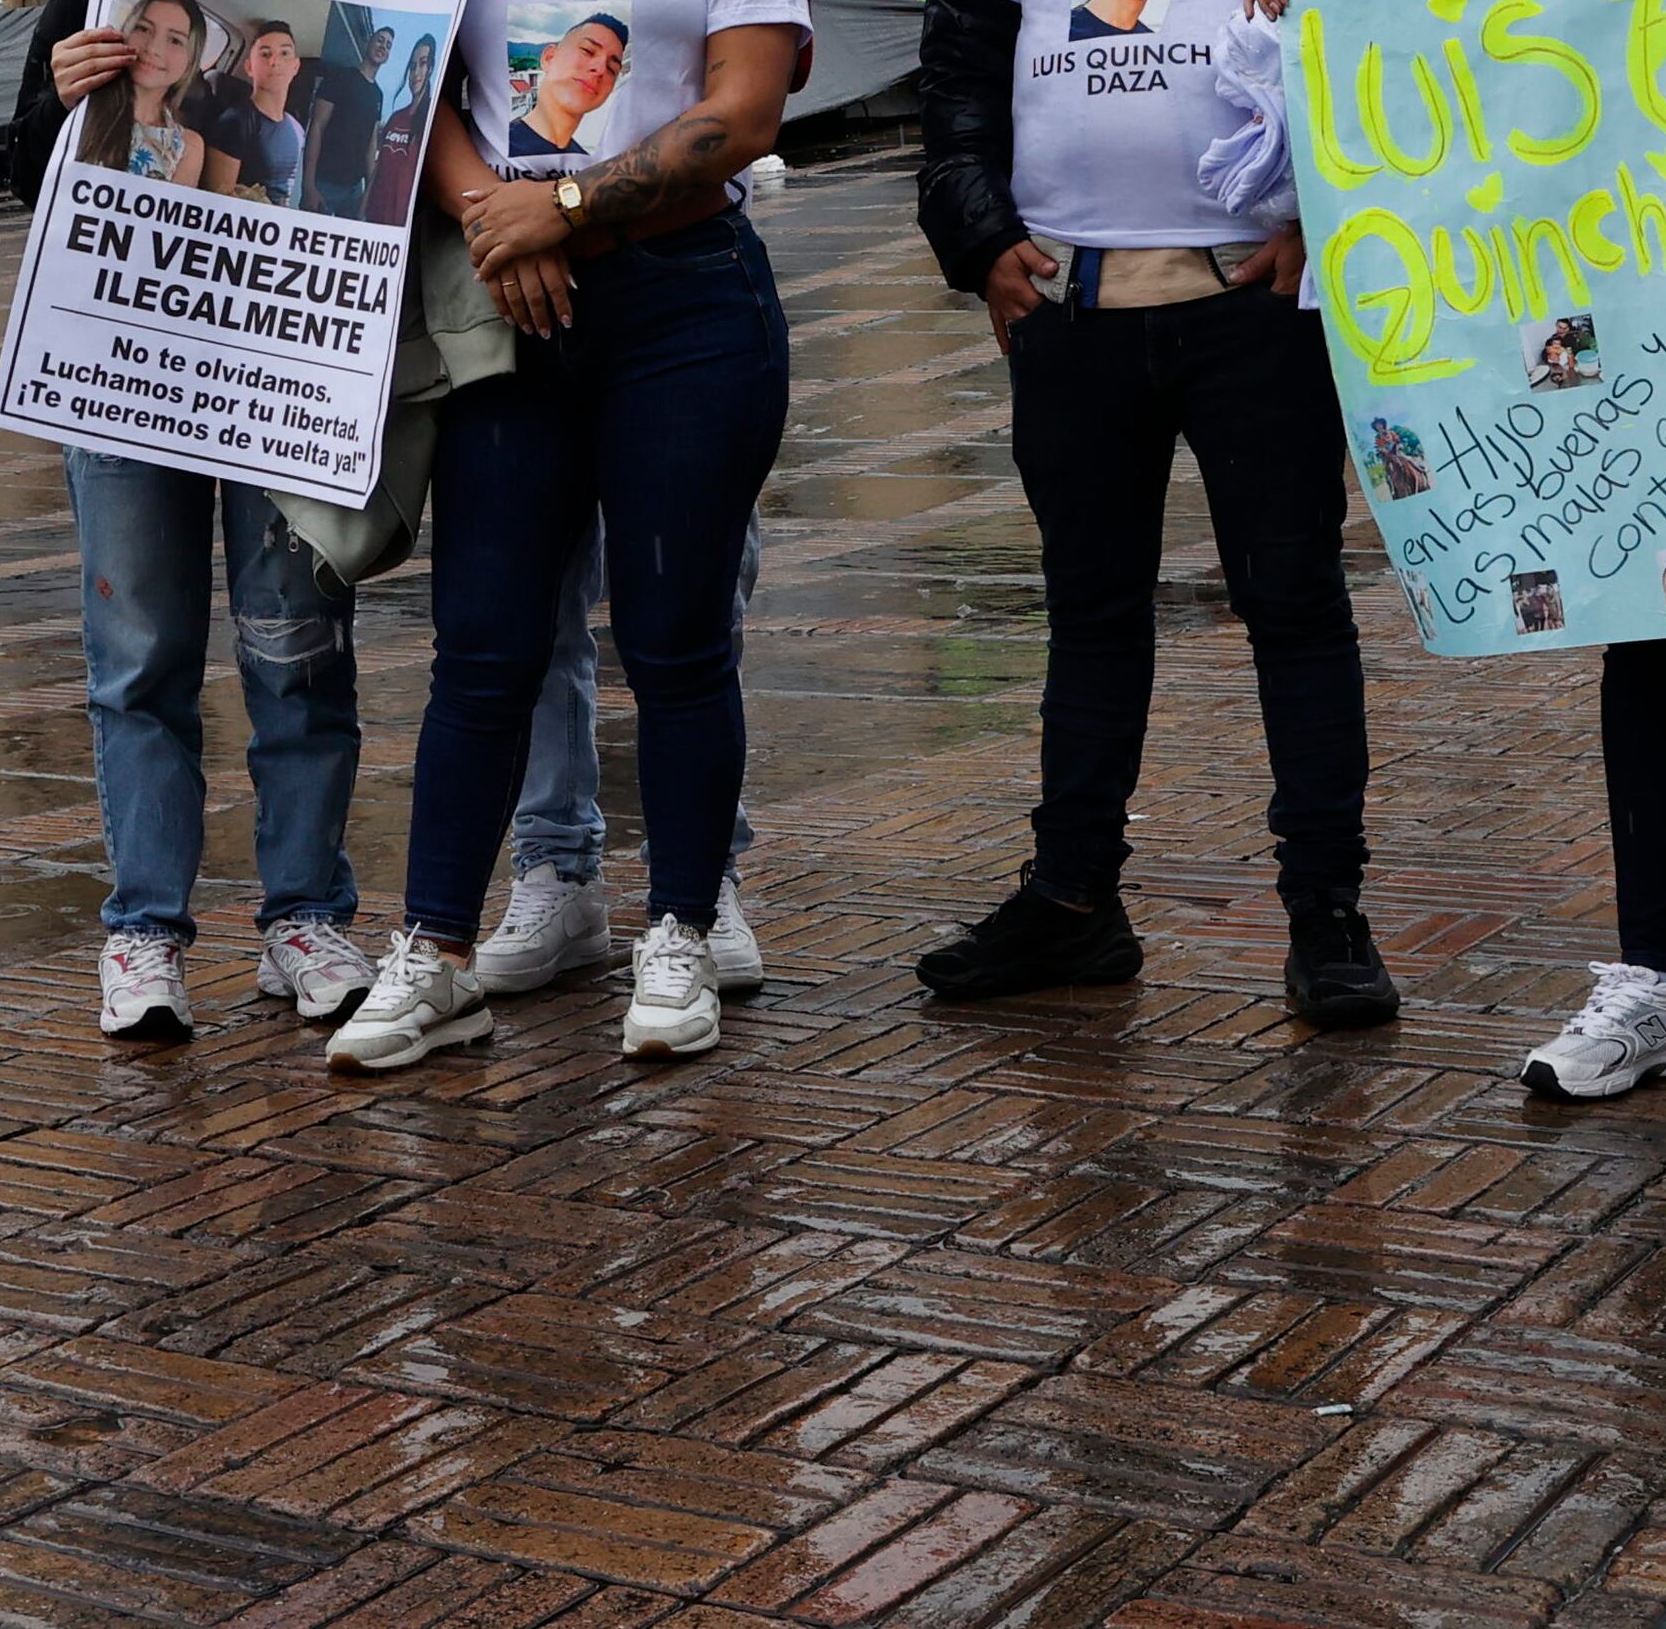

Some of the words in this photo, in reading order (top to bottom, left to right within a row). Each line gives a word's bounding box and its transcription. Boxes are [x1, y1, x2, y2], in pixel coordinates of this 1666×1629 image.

[1032, 50, 1076, 79] LUIS
[1087, 70, 1168, 95] DAZA
[66, 213, 134, 261] EN
[151, 231, 388, 315] VENEZUELA
[71, 180, 280, 246] COLOMBIANO
[288, 227, 400, 269] RETENIDO
[93, 268, 365, 355] ILEGALMENTE
[40, 352, 184, 404] Luchamos
[192, 390, 240, 416] por
[247, 398, 274, 423] tu
[282, 405, 359, 443] libertad.
[111, 336, 149, 365] No
[158, 347, 186, 372] te
[195, 358, 332, 404] olvidamos.
[17, 380, 61, 407] ¡Te
[70, 395, 209, 441] queremos
[218, 424, 252, 450] de
[261, 436, 330, 467] vuelta
[1521, 447, 1642, 562] malas
